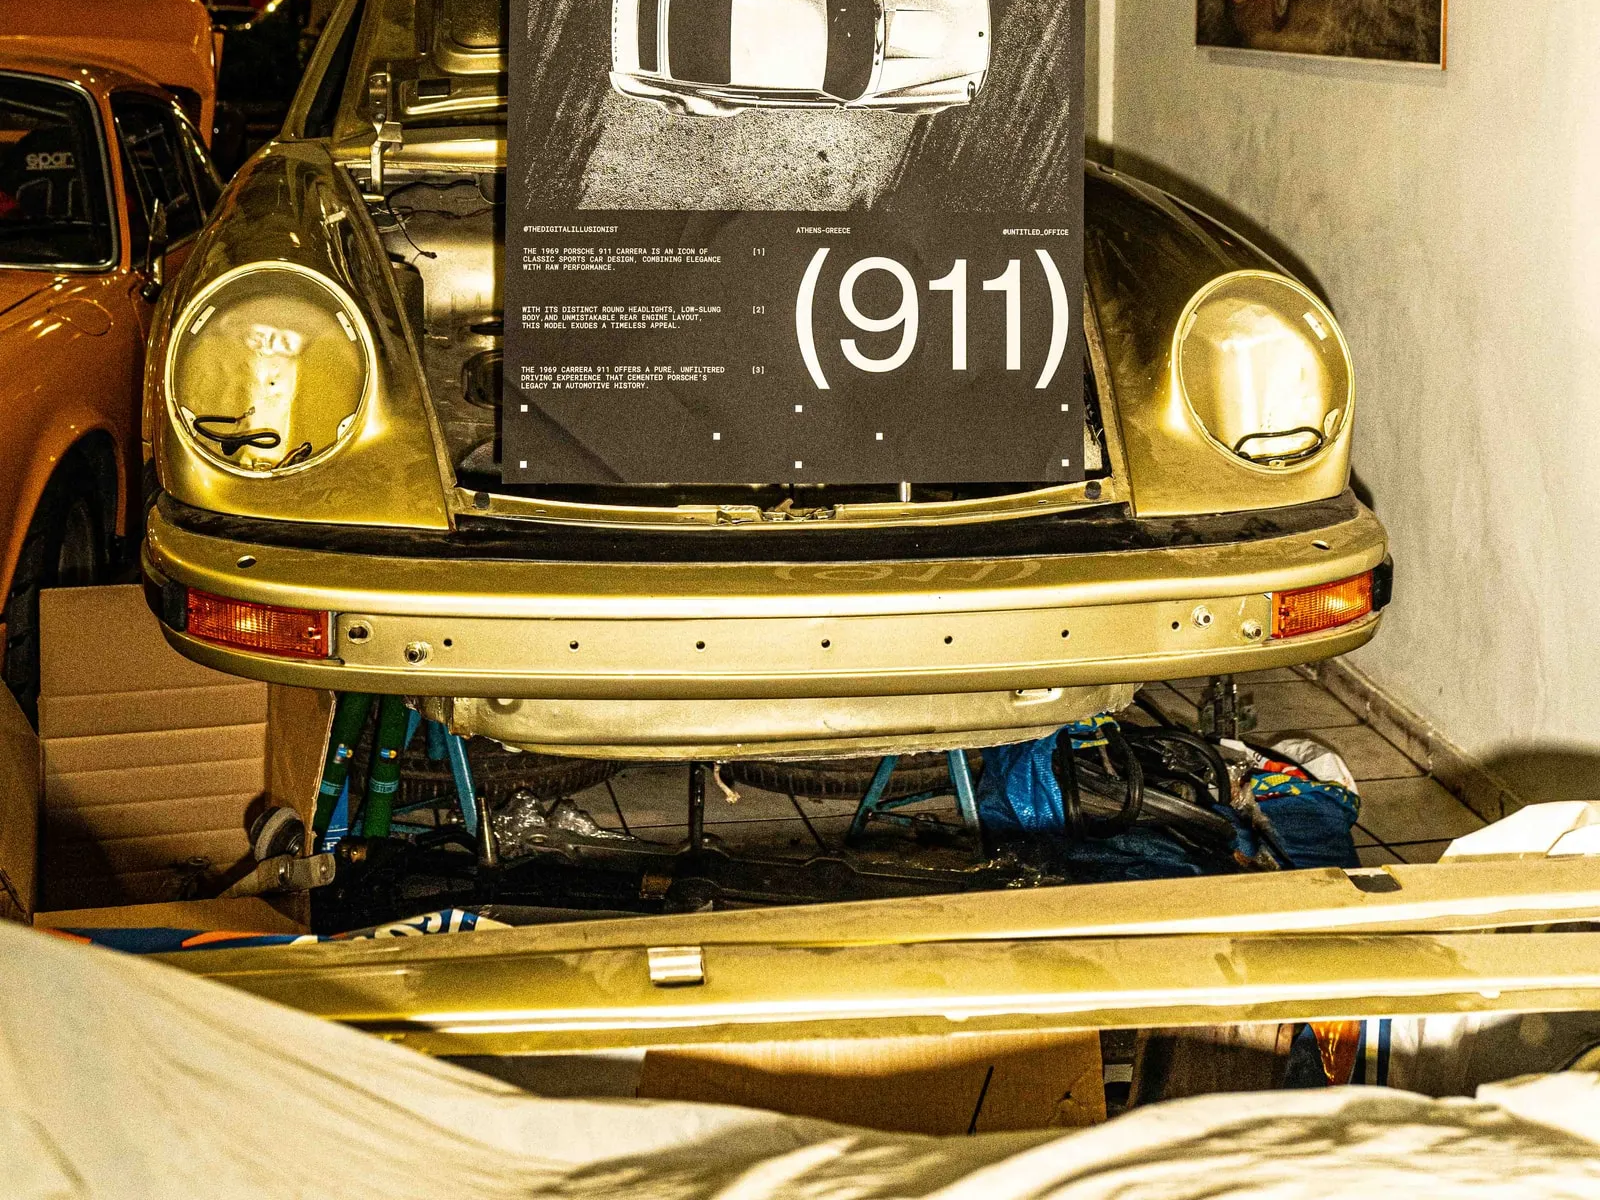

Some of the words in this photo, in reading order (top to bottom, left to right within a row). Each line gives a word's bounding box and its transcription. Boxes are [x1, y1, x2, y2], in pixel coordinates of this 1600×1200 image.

[523, 225, 619, 233] @THEDIGITALILLUSIONIST
[795, 226, 851, 235] ATHENS-GREECE
[1002, 228, 1070, 236] @UNTITLED_OFFICE
[522, 247, 537, 255] THE
[541, 247, 560, 255] 1969
[563, 247, 595, 255] PORSCHE
[598, 247, 612, 255] 911
[615, 247, 648, 255] CARRERA
[651, 247, 661, 255] IS
[663, 247, 674, 255] AN
[677, 247, 696, 255] ICON
[698, 247, 708, 255] OF
[752, 247, 765, 257] [1]
[522, 255, 555, 263] CLASSIC
[558, 255, 586, 263] SPORTS
[589, 255, 604, 263] CAR
[607, 255, 637, 264] DESIGN,
[642, 255, 683, 263] COMBINING
[685, 255, 722, 263] ELEGANCE
[522, 263, 542, 271] WITH
[544, 263, 560, 271] RAW
[562, 263, 616, 271] PERFORMANCE.
[521, 305, 541, 314] WITH
[544, 305, 559, 314] ITS
[561, 305, 598, 313] DISTINCT
[601, 305, 625, 313] ROUND
[628, 305, 676, 314] HEADLIGHTS,
[680, 305, 722, 314] LOW-SLUNG
[752, 305, 765, 315] [2]
[561, 313, 616, 321] UNMISTAKABLE
[619, 313, 638, 321] REAR
[641, 313, 669, 321] ENGINE
[672, 313, 702, 322] LAYOUT,
[795, 247, 1069, 390] (911)
[521, 321, 541, 330] THIS
[543, 321, 567, 329] MODEL
[570, 321, 598, 330] EXUDES
[610, 321, 647, 329] TIMELESS
[649, 321, 681, 329] APPEAL.
[520, 366, 535, 374] THE
[539, 366, 558, 374] 1969
[560, 366, 593, 374] CARRERA
[596, 365, 610, 373] 911
[613, 365, 642, 374] OFFERS
[644, 365, 651, 373] A
[653, 365, 675, 374] PURE,
[680, 365, 726, 374] UNFILTERED
[752, 365, 765, 375] [3]
[520, 373, 553, 382] DRIVING
[556, 373, 602, 382] EXPERIENCE
[605, 373, 624, 381] THAT
[627, 373, 664, 382] CEMENTED
[520, 382, 549, 390] LEGACY
[551, 382, 562, 390] IN
[565, 381, 610, 390] AUTOMOTIVE
[613, 381, 649, 390] HISTORY.
